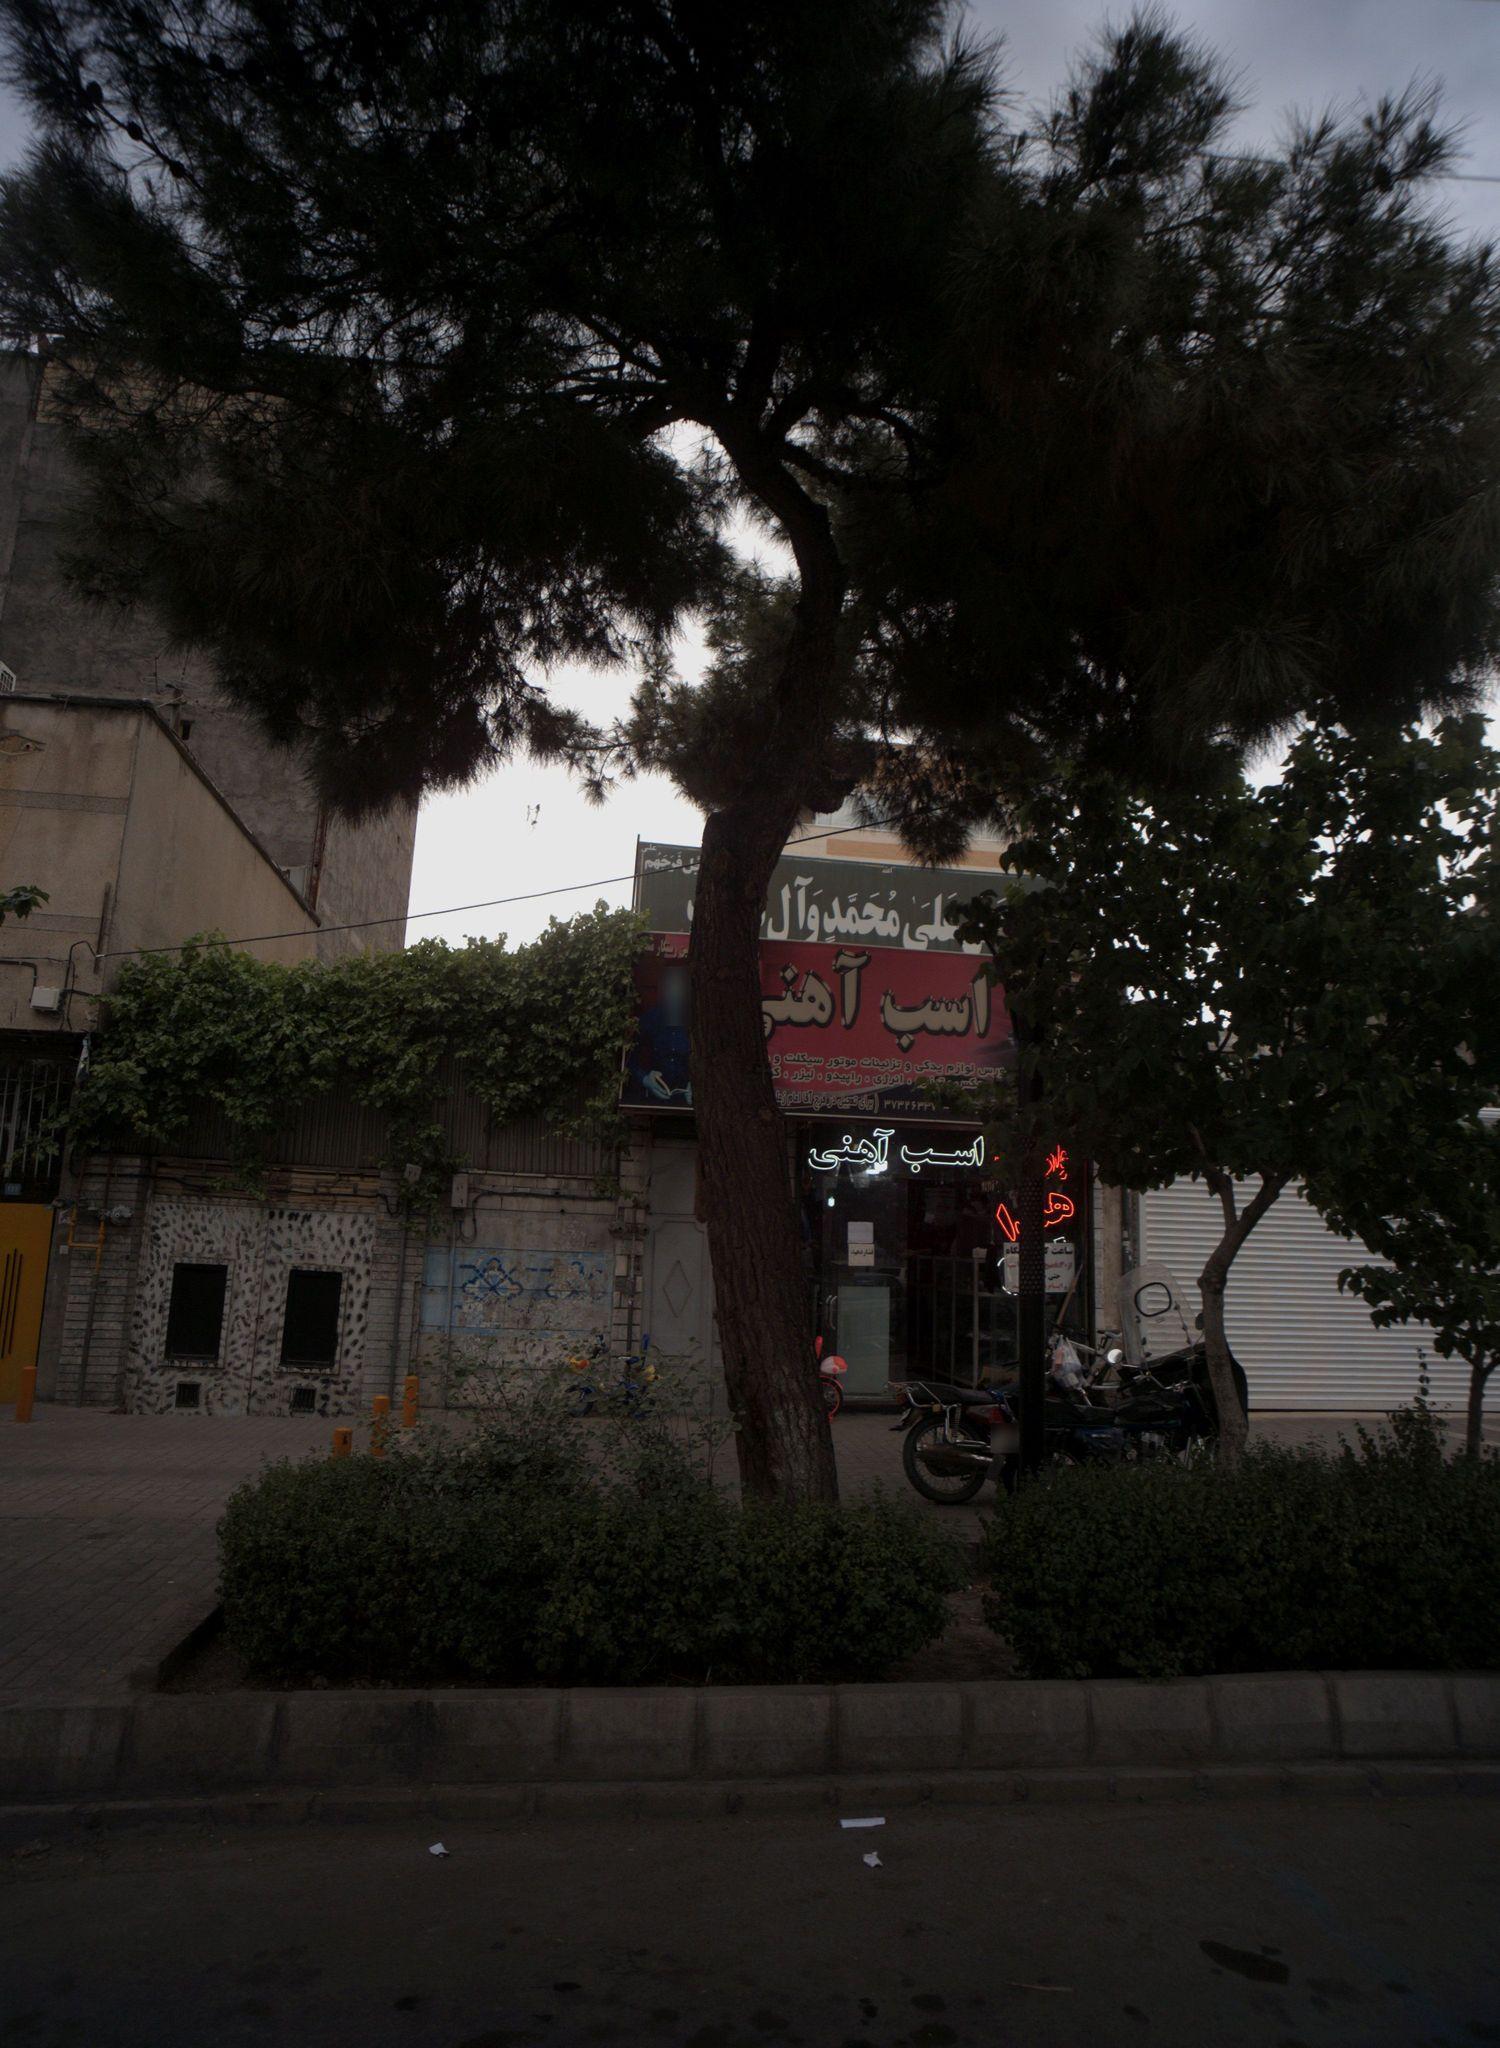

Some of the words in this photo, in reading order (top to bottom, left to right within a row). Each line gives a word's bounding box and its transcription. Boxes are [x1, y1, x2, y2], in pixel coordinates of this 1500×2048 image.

[880, 962, 997, 1052] اسب
[773, 1054, 781, 1065] و
[785, 1052, 823, 1067] سیکلت
[826, 1056, 858, 1070] موتور
[904, 1061, 912, 1072] و
[915, 1060, 945, 1074] یدکی
[792, 1067, 816, 1082] لیزر
[946, 1062, 976, 1077] لوازم
[825, 1070, 862, 1085] راپیدو
[872, 1073, 904, 1087] انرژی
[808, 1128, 895, 1170] آهنی
[901, 1135, 985, 1173] اسب
